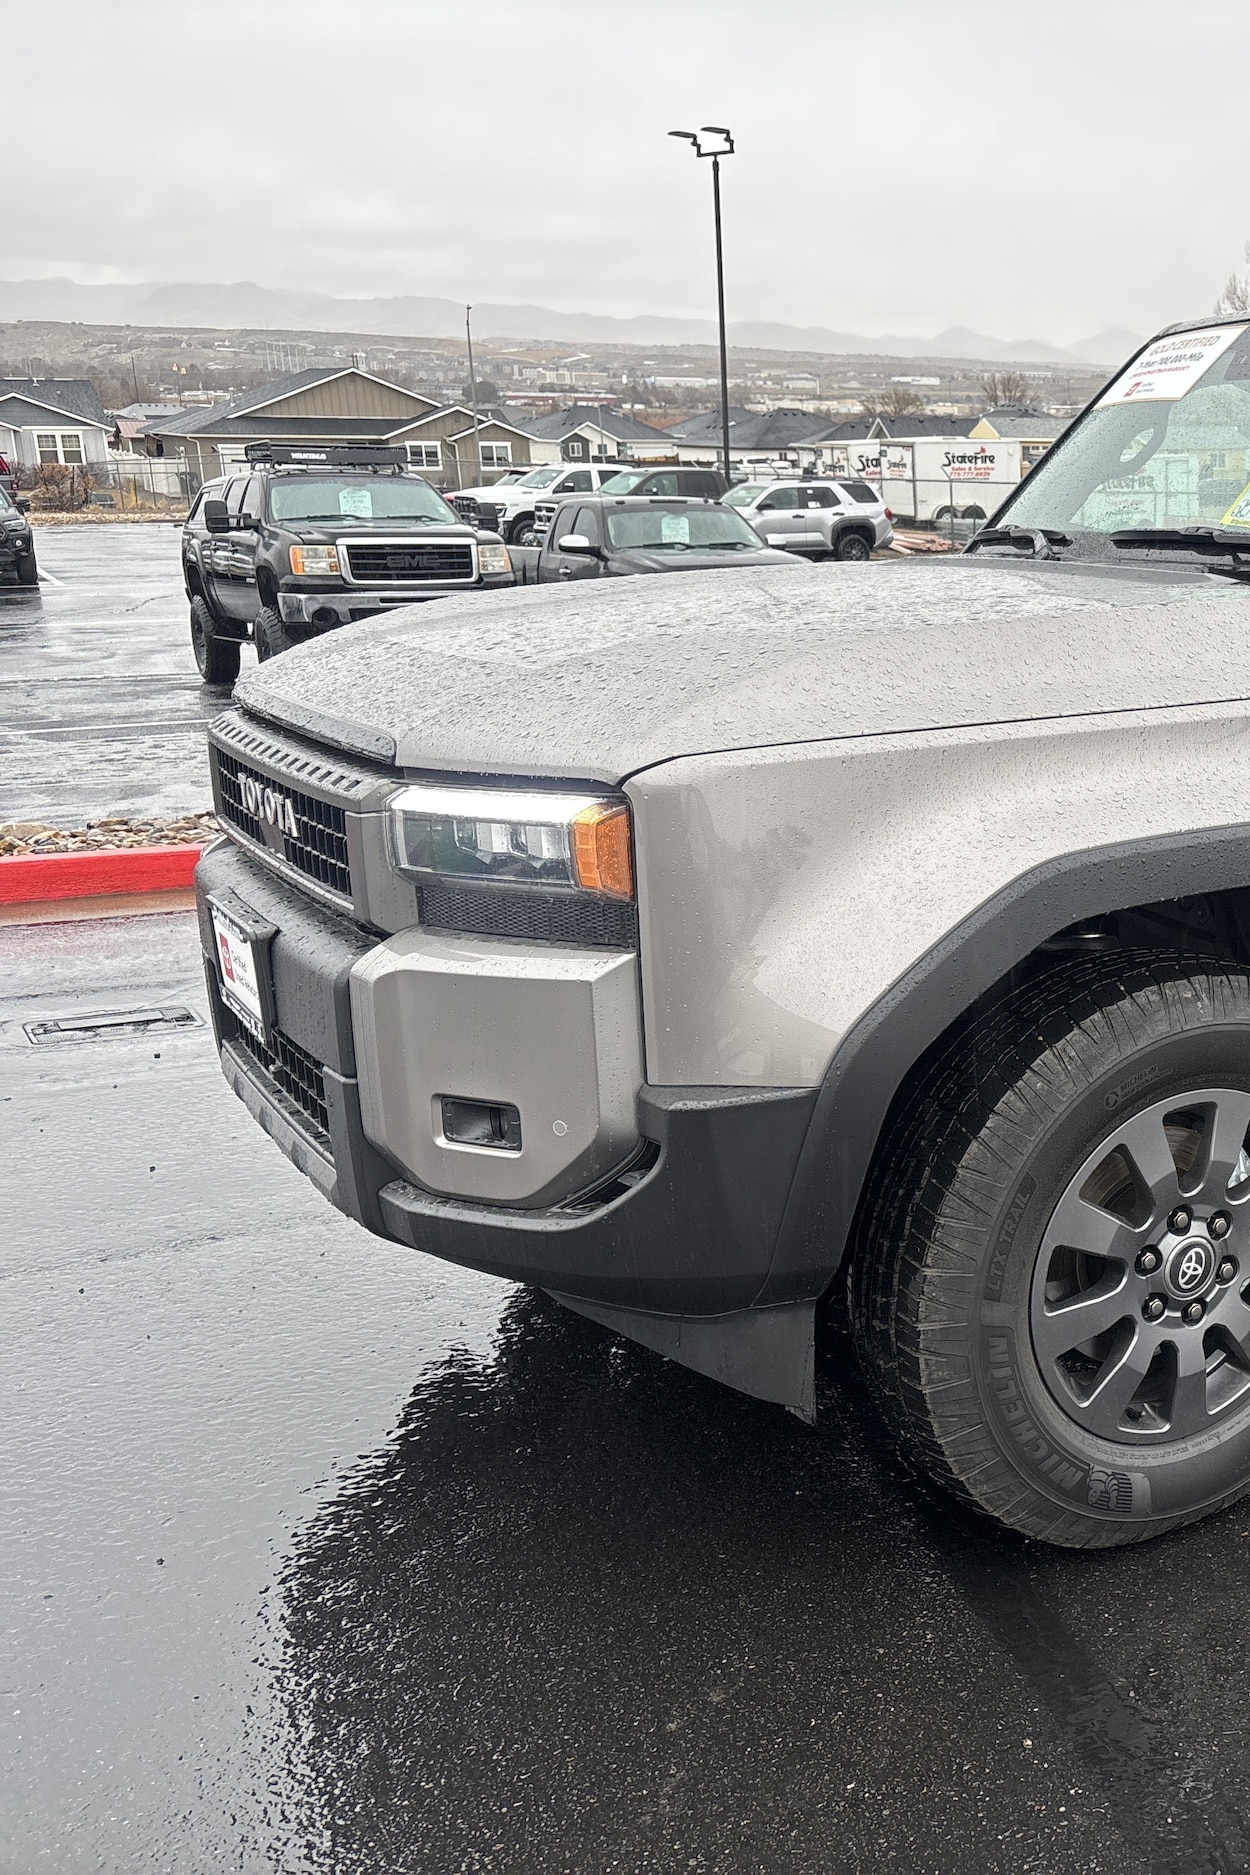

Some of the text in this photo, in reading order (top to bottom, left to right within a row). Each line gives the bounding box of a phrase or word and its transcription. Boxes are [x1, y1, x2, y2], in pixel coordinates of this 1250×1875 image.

[1149, 335, 1221, 357] GOLD CERTIFIED
[290, 452, 327, 460] YAKIMA
[942, 451, 996, 467] StateFire
[386, 555, 440, 567] GMC
[237, 772, 299, 838] TOYOTA
[987, 1192, 1031, 1292] LTX TRAIL
[987, 1336, 1085, 1491] MICHELIN
